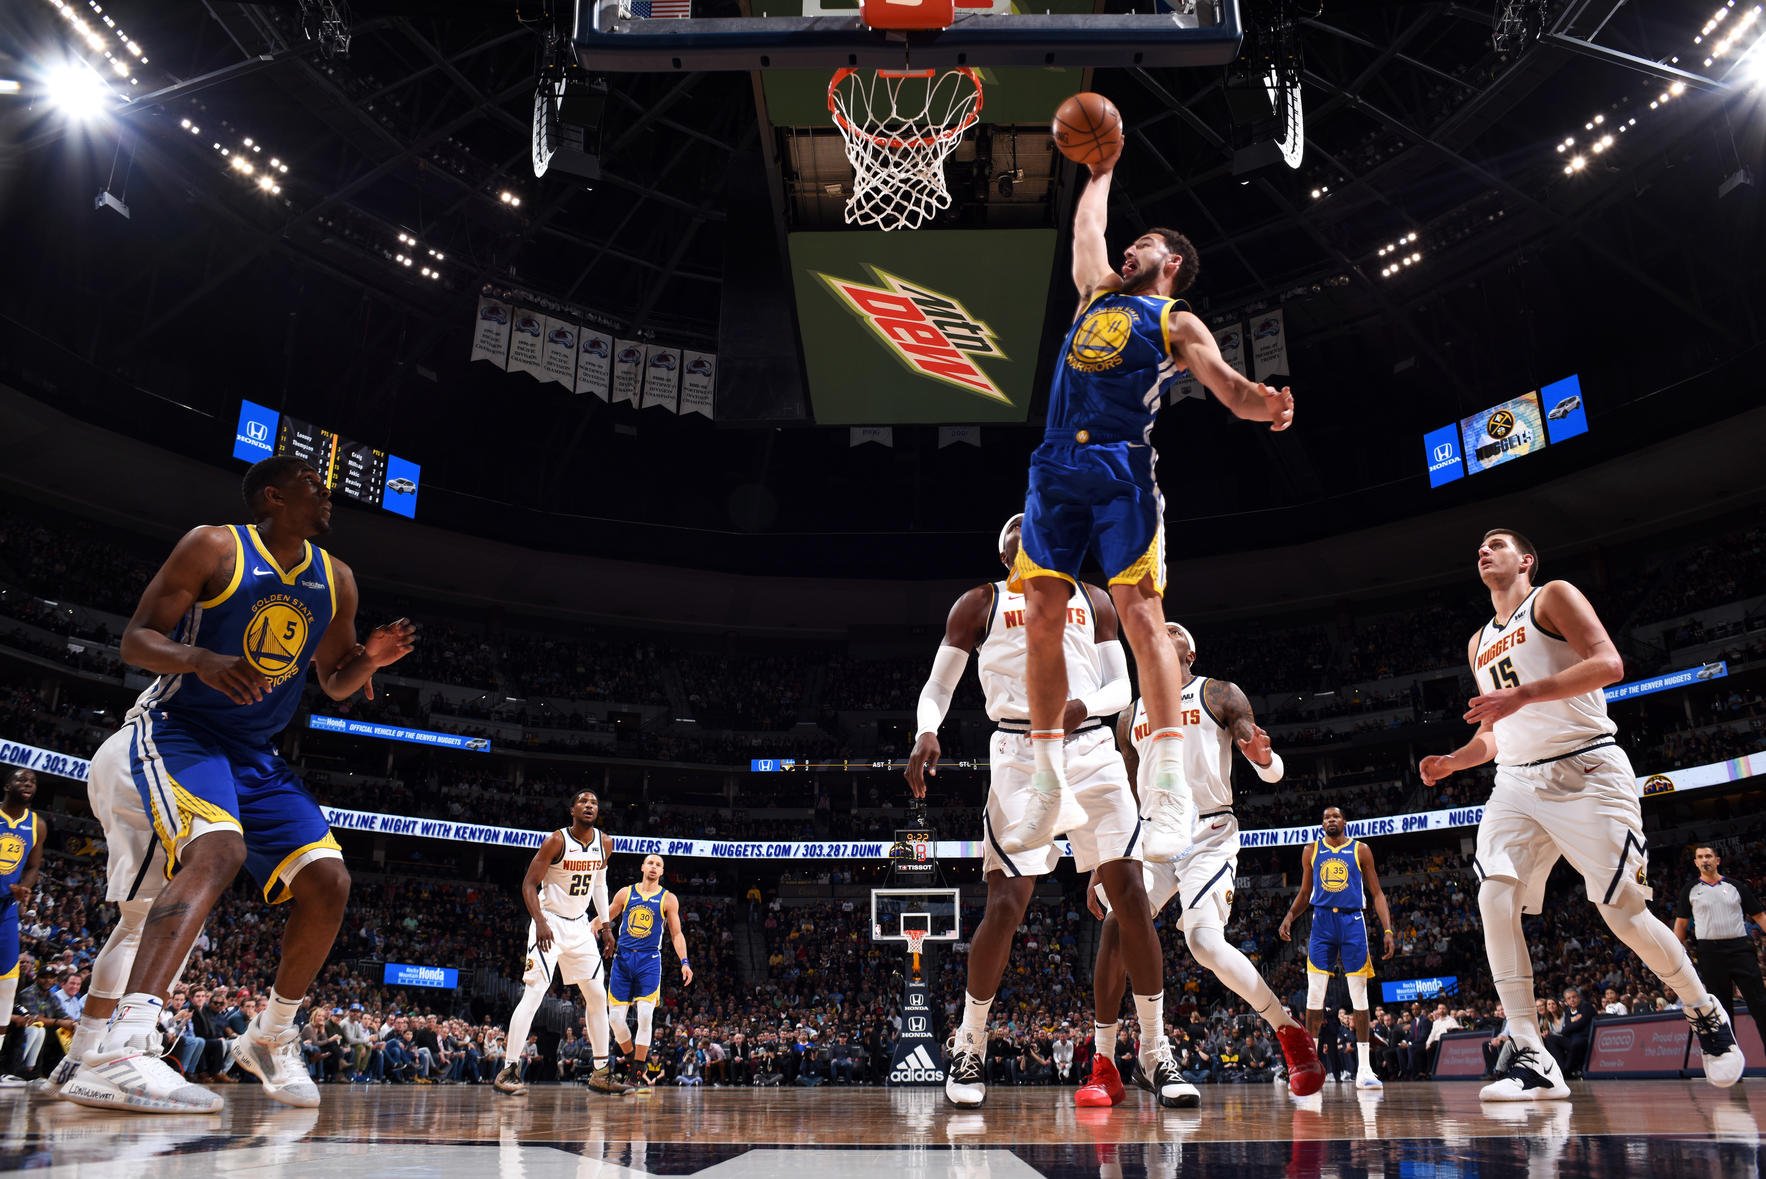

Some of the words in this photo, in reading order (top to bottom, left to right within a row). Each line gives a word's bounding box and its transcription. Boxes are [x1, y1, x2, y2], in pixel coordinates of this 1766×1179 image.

[1066, 352, 1124, 373] WARRIORS
[237, 434, 272, 452] HONDA
[1475, 430, 1533, 461] NUGGETS
[295, 450, 308, 460] Green
[351, 451, 363, 462] Craig
[1429, 456, 1461, 472] HONDA
[251, 593, 291, 613] GOLDEN
[291, 598, 315, 624] STATE
[1004, 607, 1086, 629] NUTS
[282, 620, 297, 641] 5
[1477, 626, 1526, 670] NUGGETS
[264, 664, 300, 688] RIORS
[1489, 656, 1520, 689] 15
[1620, 688, 1628, 697] OF
[1629, 686, 1639, 694] THE
[1640, 679, 1663, 691] DENVER
[1664, 673, 1692, 686] NUGGETS
[349, 723, 373, 734] OFFICIAL
[374, 726, 396, 737] VEHICLE
[405, 731, 415, 739] THE
[415, 732, 437, 743] DENVER
[437, 735, 462, 746] NUGGETS
[1134, 708, 1201, 742] NUTS
[327, 810, 377, 830] SKYLINE
[380, 816, 419, 833] NIGHT
[420, 821, 452, 837] WITH
[453, 824, 500, 842] KENYON
[502, 829, 547, 848] MARTIN
[1283, 828, 1308, 843] 1/19
[1402, 815, 1428, 831] 8PM
[7, 843, 21, 853] 23
[612, 837, 661, 854] VALIERS
[668, 840, 693, 854] 8PM
[711, 843, 792, 857] NUGGETS.COM
[793, 844, 800, 857] /
[802, 843, 882, 857] 303.287.DUNK
[563, 860, 601, 871] NUGGETS
[1333, 866, 1344, 874] 35
[569, 874, 592, 896] 25
[640, 913, 650, 921] 30
[419, 967, 444, 980] Honda
[1415, 978, 1442, 992] Honda
[890, 1068, 944, 1082] adidas
